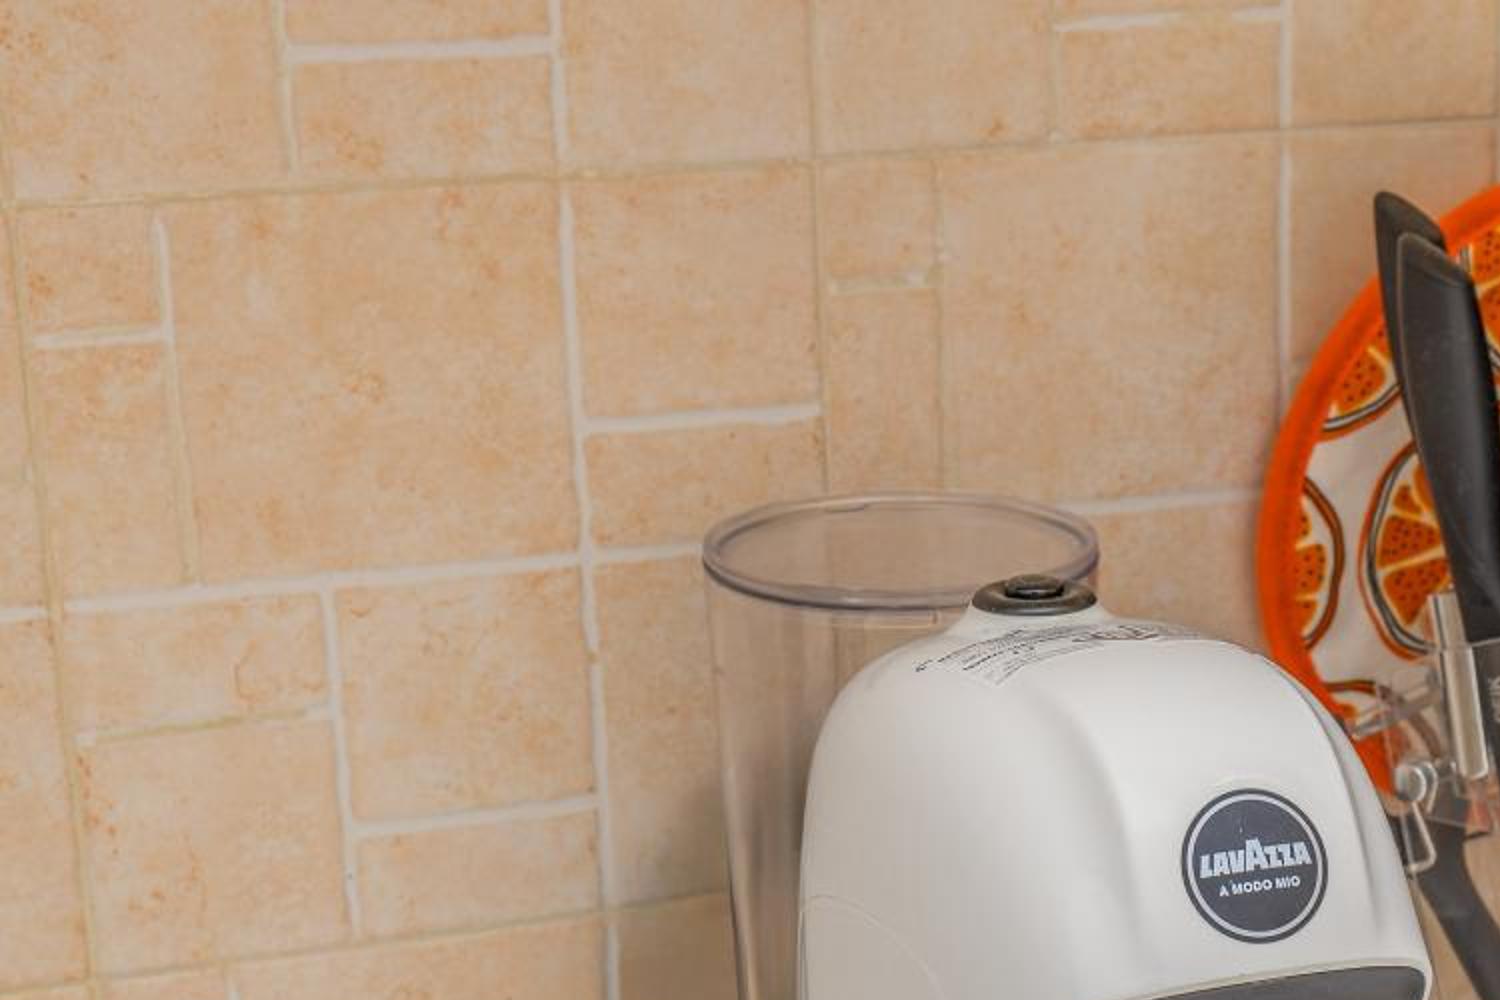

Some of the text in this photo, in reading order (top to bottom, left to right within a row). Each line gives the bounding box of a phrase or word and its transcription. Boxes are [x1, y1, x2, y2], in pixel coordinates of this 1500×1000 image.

[1200, 837, 1312, 878] LAVAZZA
[1219, 875, 1301, 896] A MODO MIO
